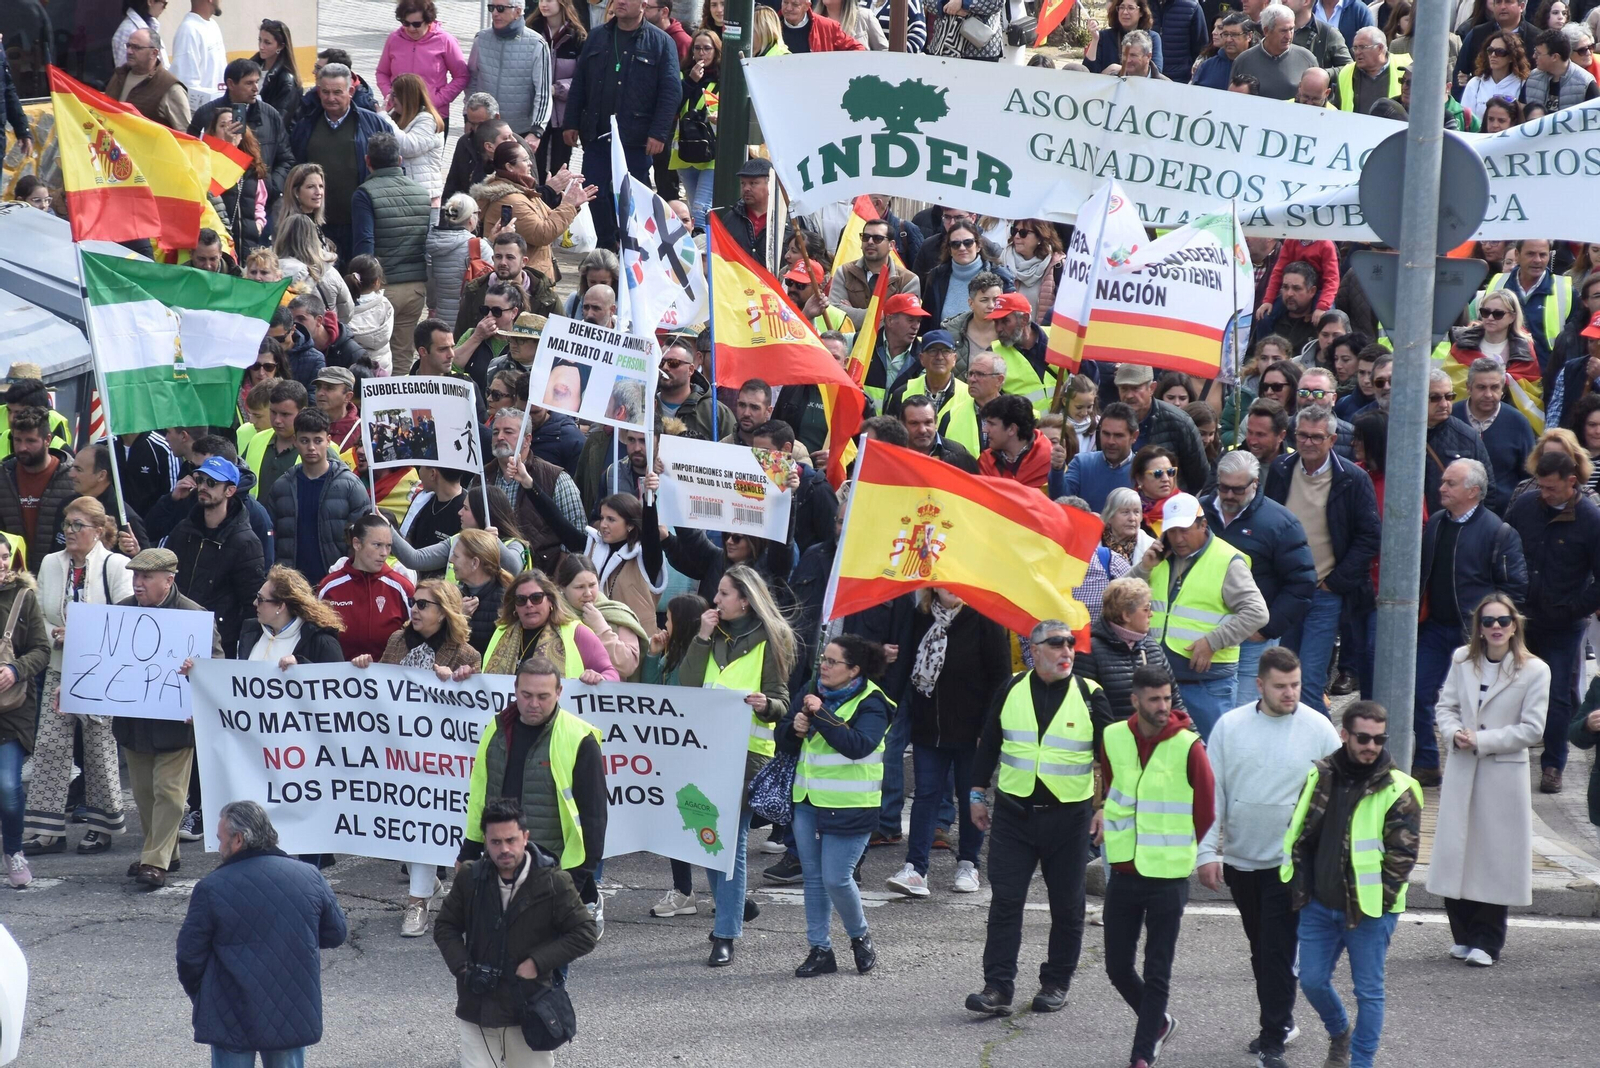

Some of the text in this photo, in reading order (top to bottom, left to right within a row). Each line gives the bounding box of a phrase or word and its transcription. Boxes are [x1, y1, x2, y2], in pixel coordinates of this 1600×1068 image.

[1004, 88, 1249, 153] ASOCIACIÓN
[1257, 128, 1317, 166] DE
[797, 133, 1013, 198] INDER
[1029, 132, 1266, 203] GANADEROS
[1096, 279, 1167, 307] NACIÓN
[568, 322, 621, 347] BIENESTAR
[547, 336, 601, 361] MALTRATO
[602, 351, 614, 365] AL
[362, 380, 440, 398] ¡SUBDELEGACIÓN
[677, 474, 694, 483] MALA
[697, 477, 715, 487] SALUD
[721, 481, 732, 489] LOS
[724, 470, 733, 479] SIN
[99, 611, 161, 662] NO
[69, 653, 183, 708] ZEPA
[231, 675, 379, 701] NOSOTROS
[387, 679, 490, 711] VENIMOS
[570, 693, 685, 718] TIERRA.
[218, 708, 252, 732] NO
[258, 711, 390, 734] MATEMOS
[398, 715, 433, 738] LO
[440, 717, 480, 744] QUE
[632, 724, 708, 750] VIDA.
[262, 746, 306, 770] NO
[315, 745, 336, 767] A
[341, 745, 380, 769] LA
[267, 780, 322, 804] LOS
[684, 800, 711, 812] AGACOR
[334, 813, 463, 848] AL SECTOR
